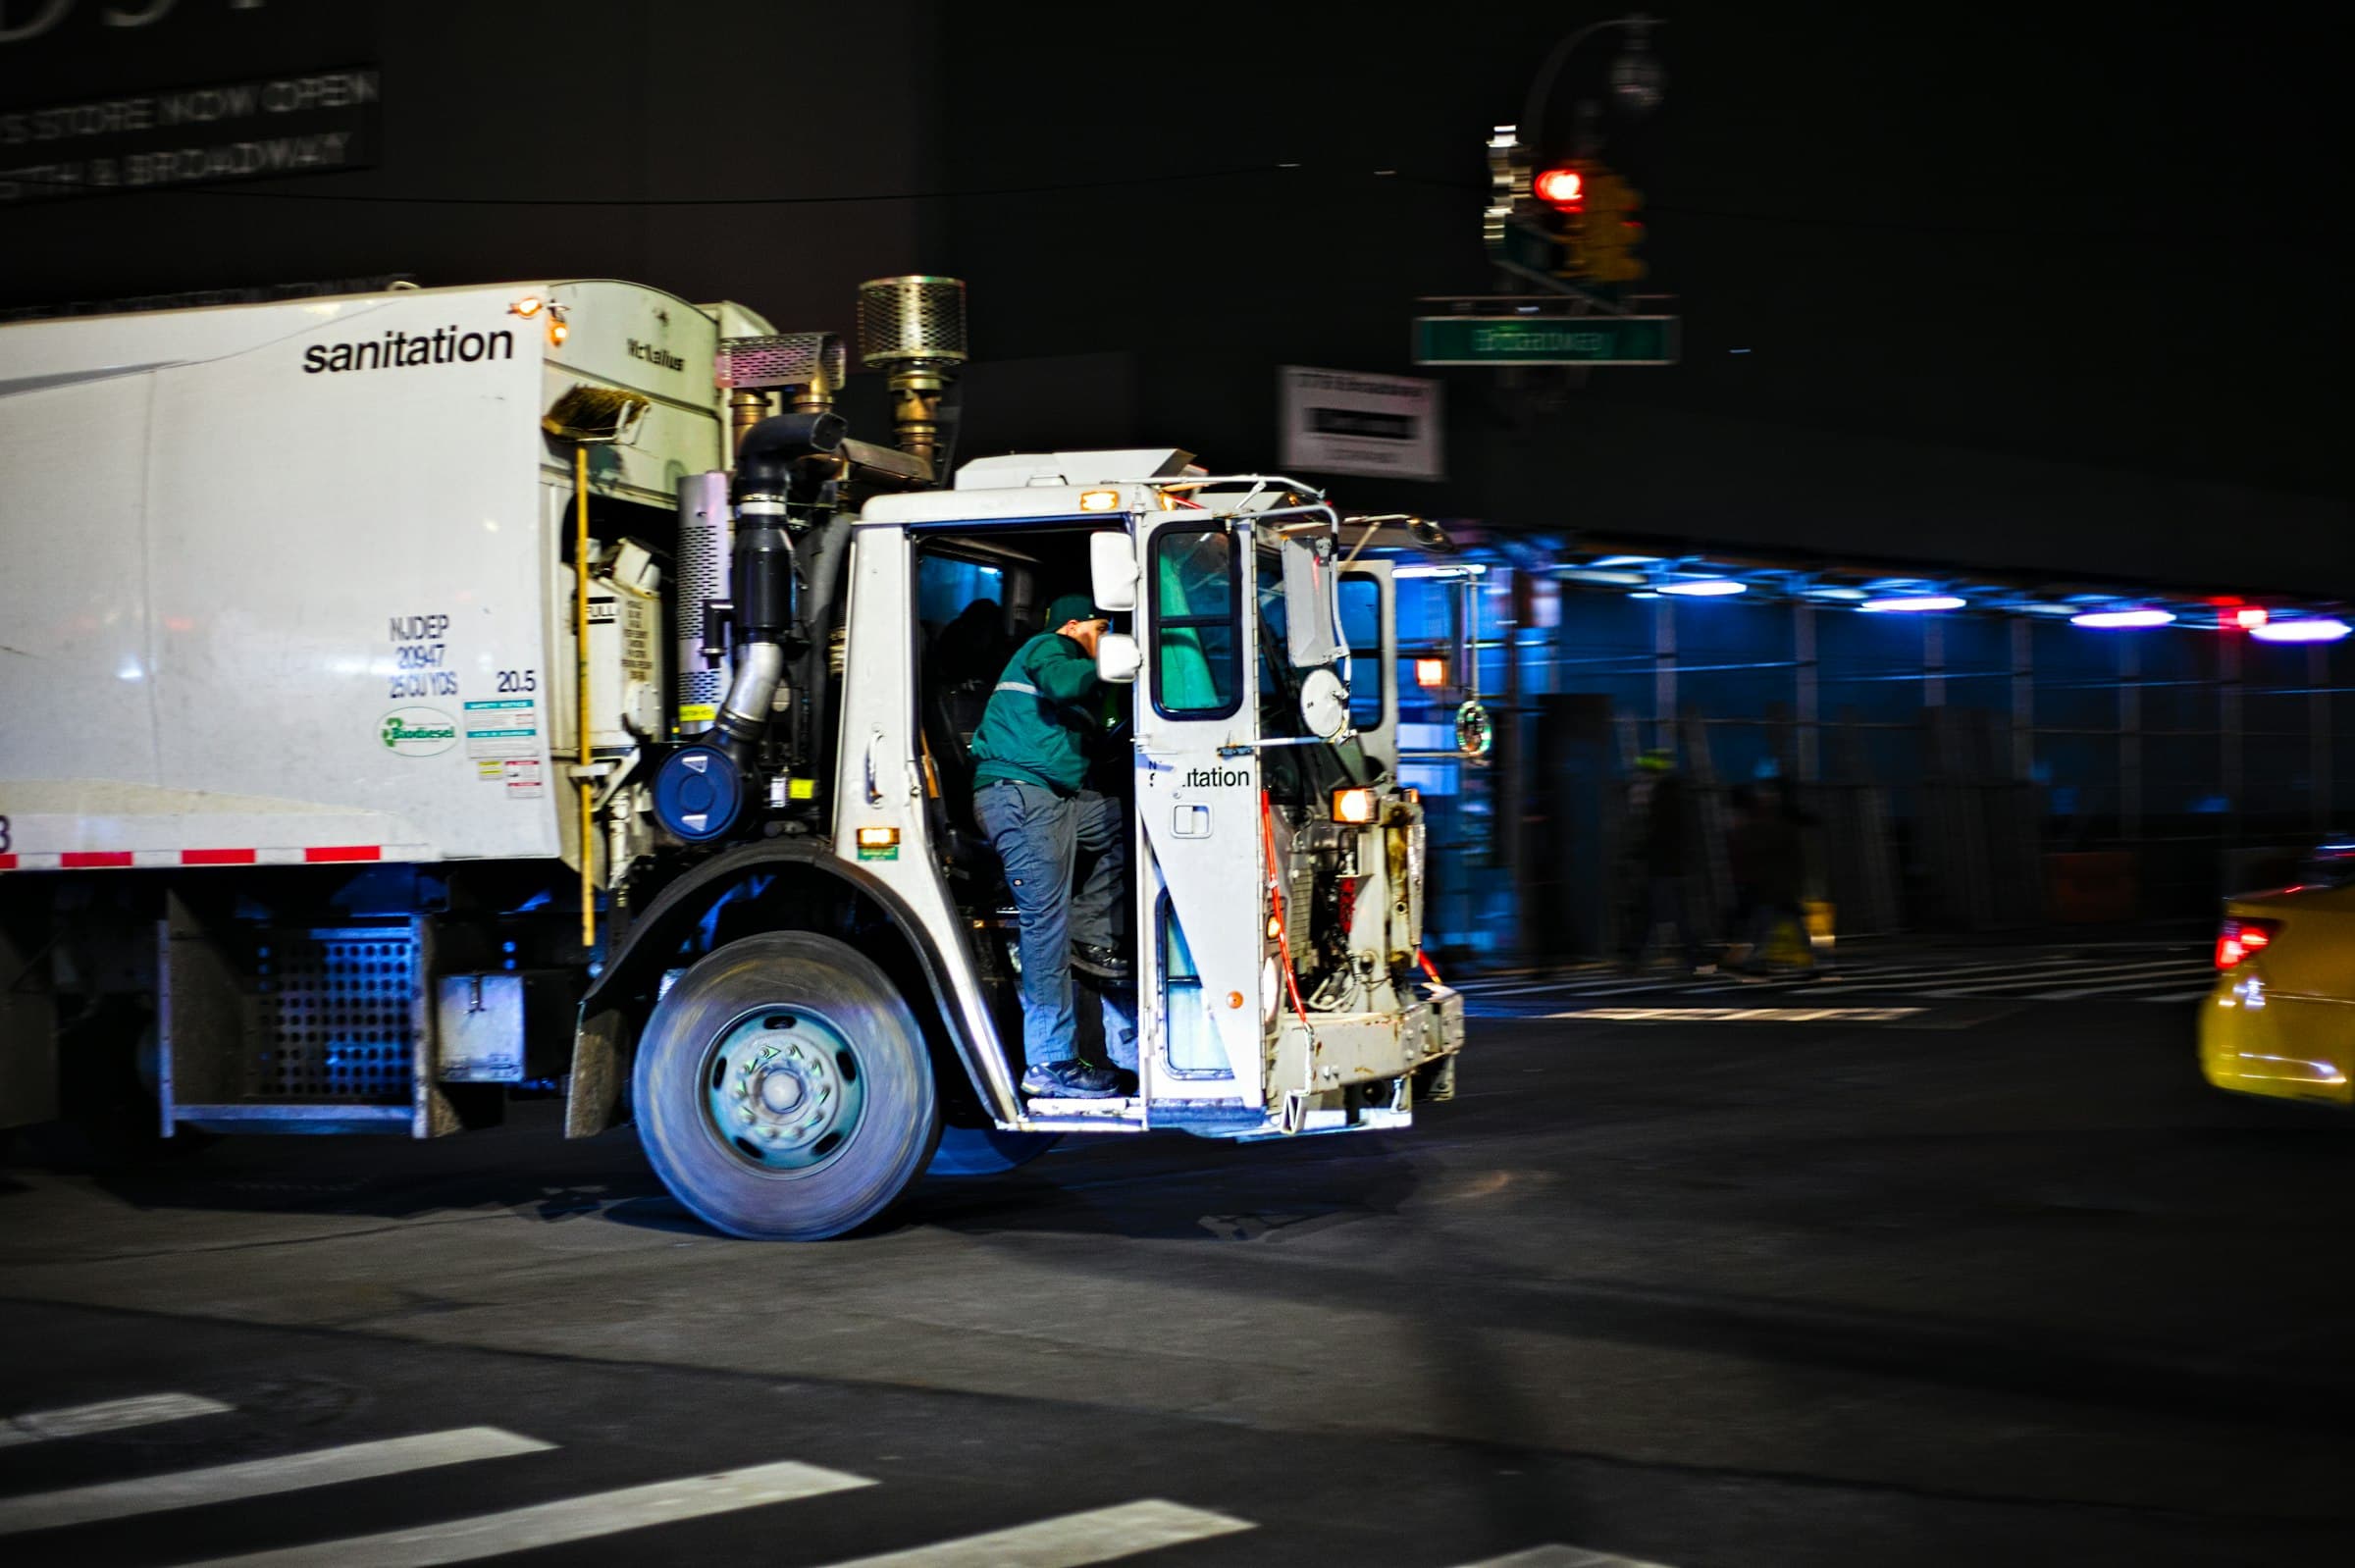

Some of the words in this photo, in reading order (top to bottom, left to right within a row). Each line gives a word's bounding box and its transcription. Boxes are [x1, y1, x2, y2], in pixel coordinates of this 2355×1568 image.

[32, 97, 155, 141] STORE
[157, 85, 259, 126] NOW
[260, 70, 381, 114] OPEN
[123, 131, 353, 186] BROADWAY
[302, 324, 513, 374] sanitation
[390, 614, 448, 641] NJDEP
[396, 644, 445, 669] 20947
[497, 670, 536, 693] 20.5
